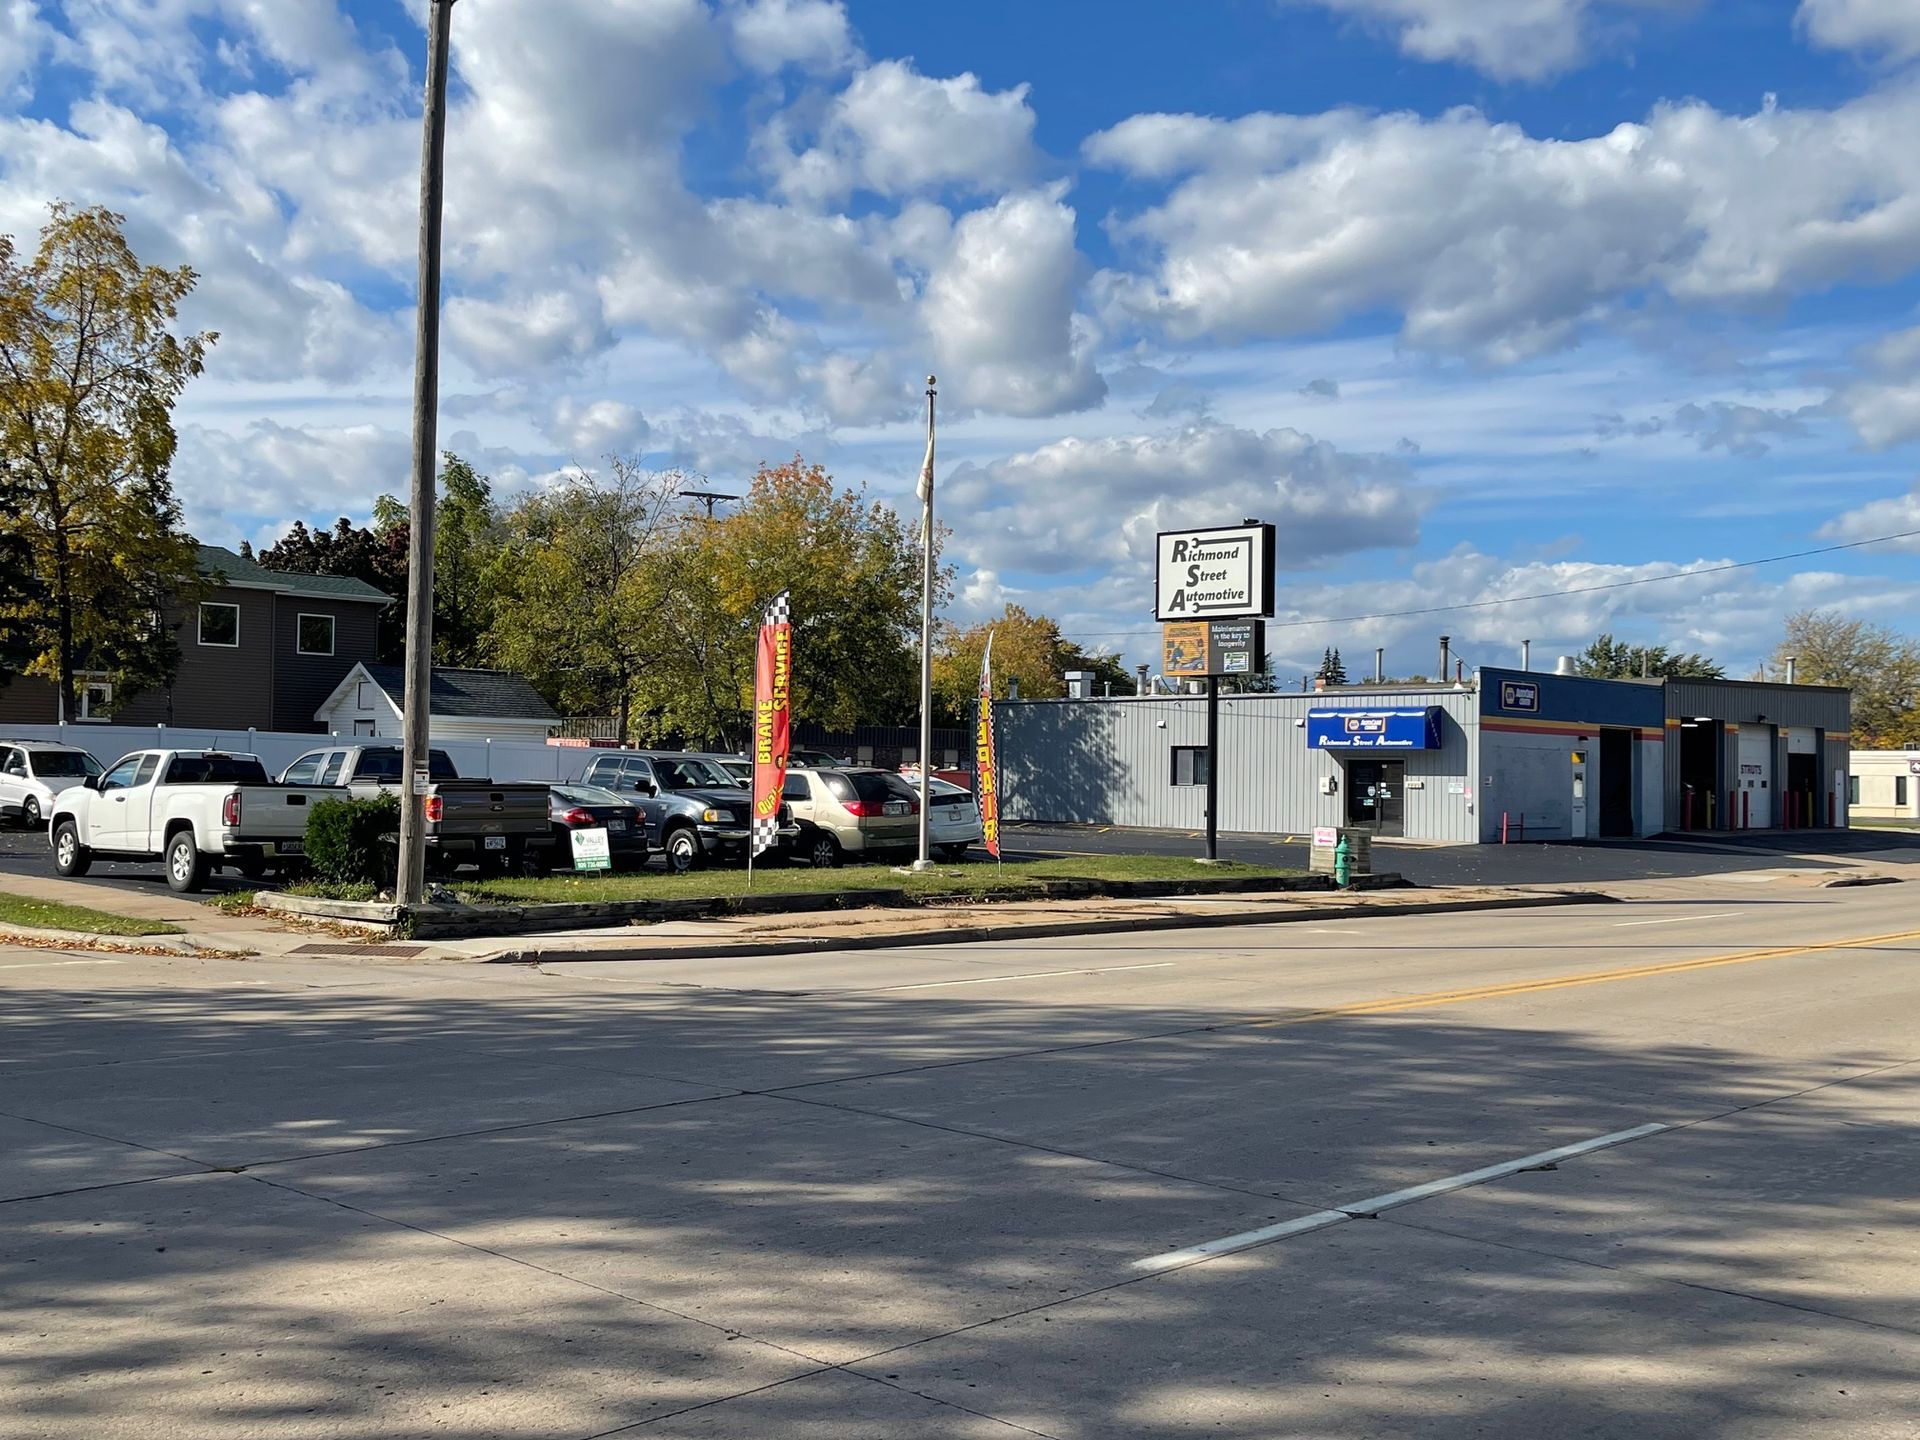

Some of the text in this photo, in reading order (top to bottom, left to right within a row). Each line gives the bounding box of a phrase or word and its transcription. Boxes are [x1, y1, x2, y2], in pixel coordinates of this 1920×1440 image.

[1171, 540, 1239, 562] Richmond
[1186, 564, 1227, 587] Street
[1168, 588, 1244, 611] Automotive
[1211, 625, 1251, 633] Maintenance
[1231, 632, 1243, 641] key
[1217, 640, 1246, 649] longevity
[772, 628, 790, 712] SERVICE
[757, 698, 774, 766] BRAKE
[1353, 735, 1373, 746] Street
